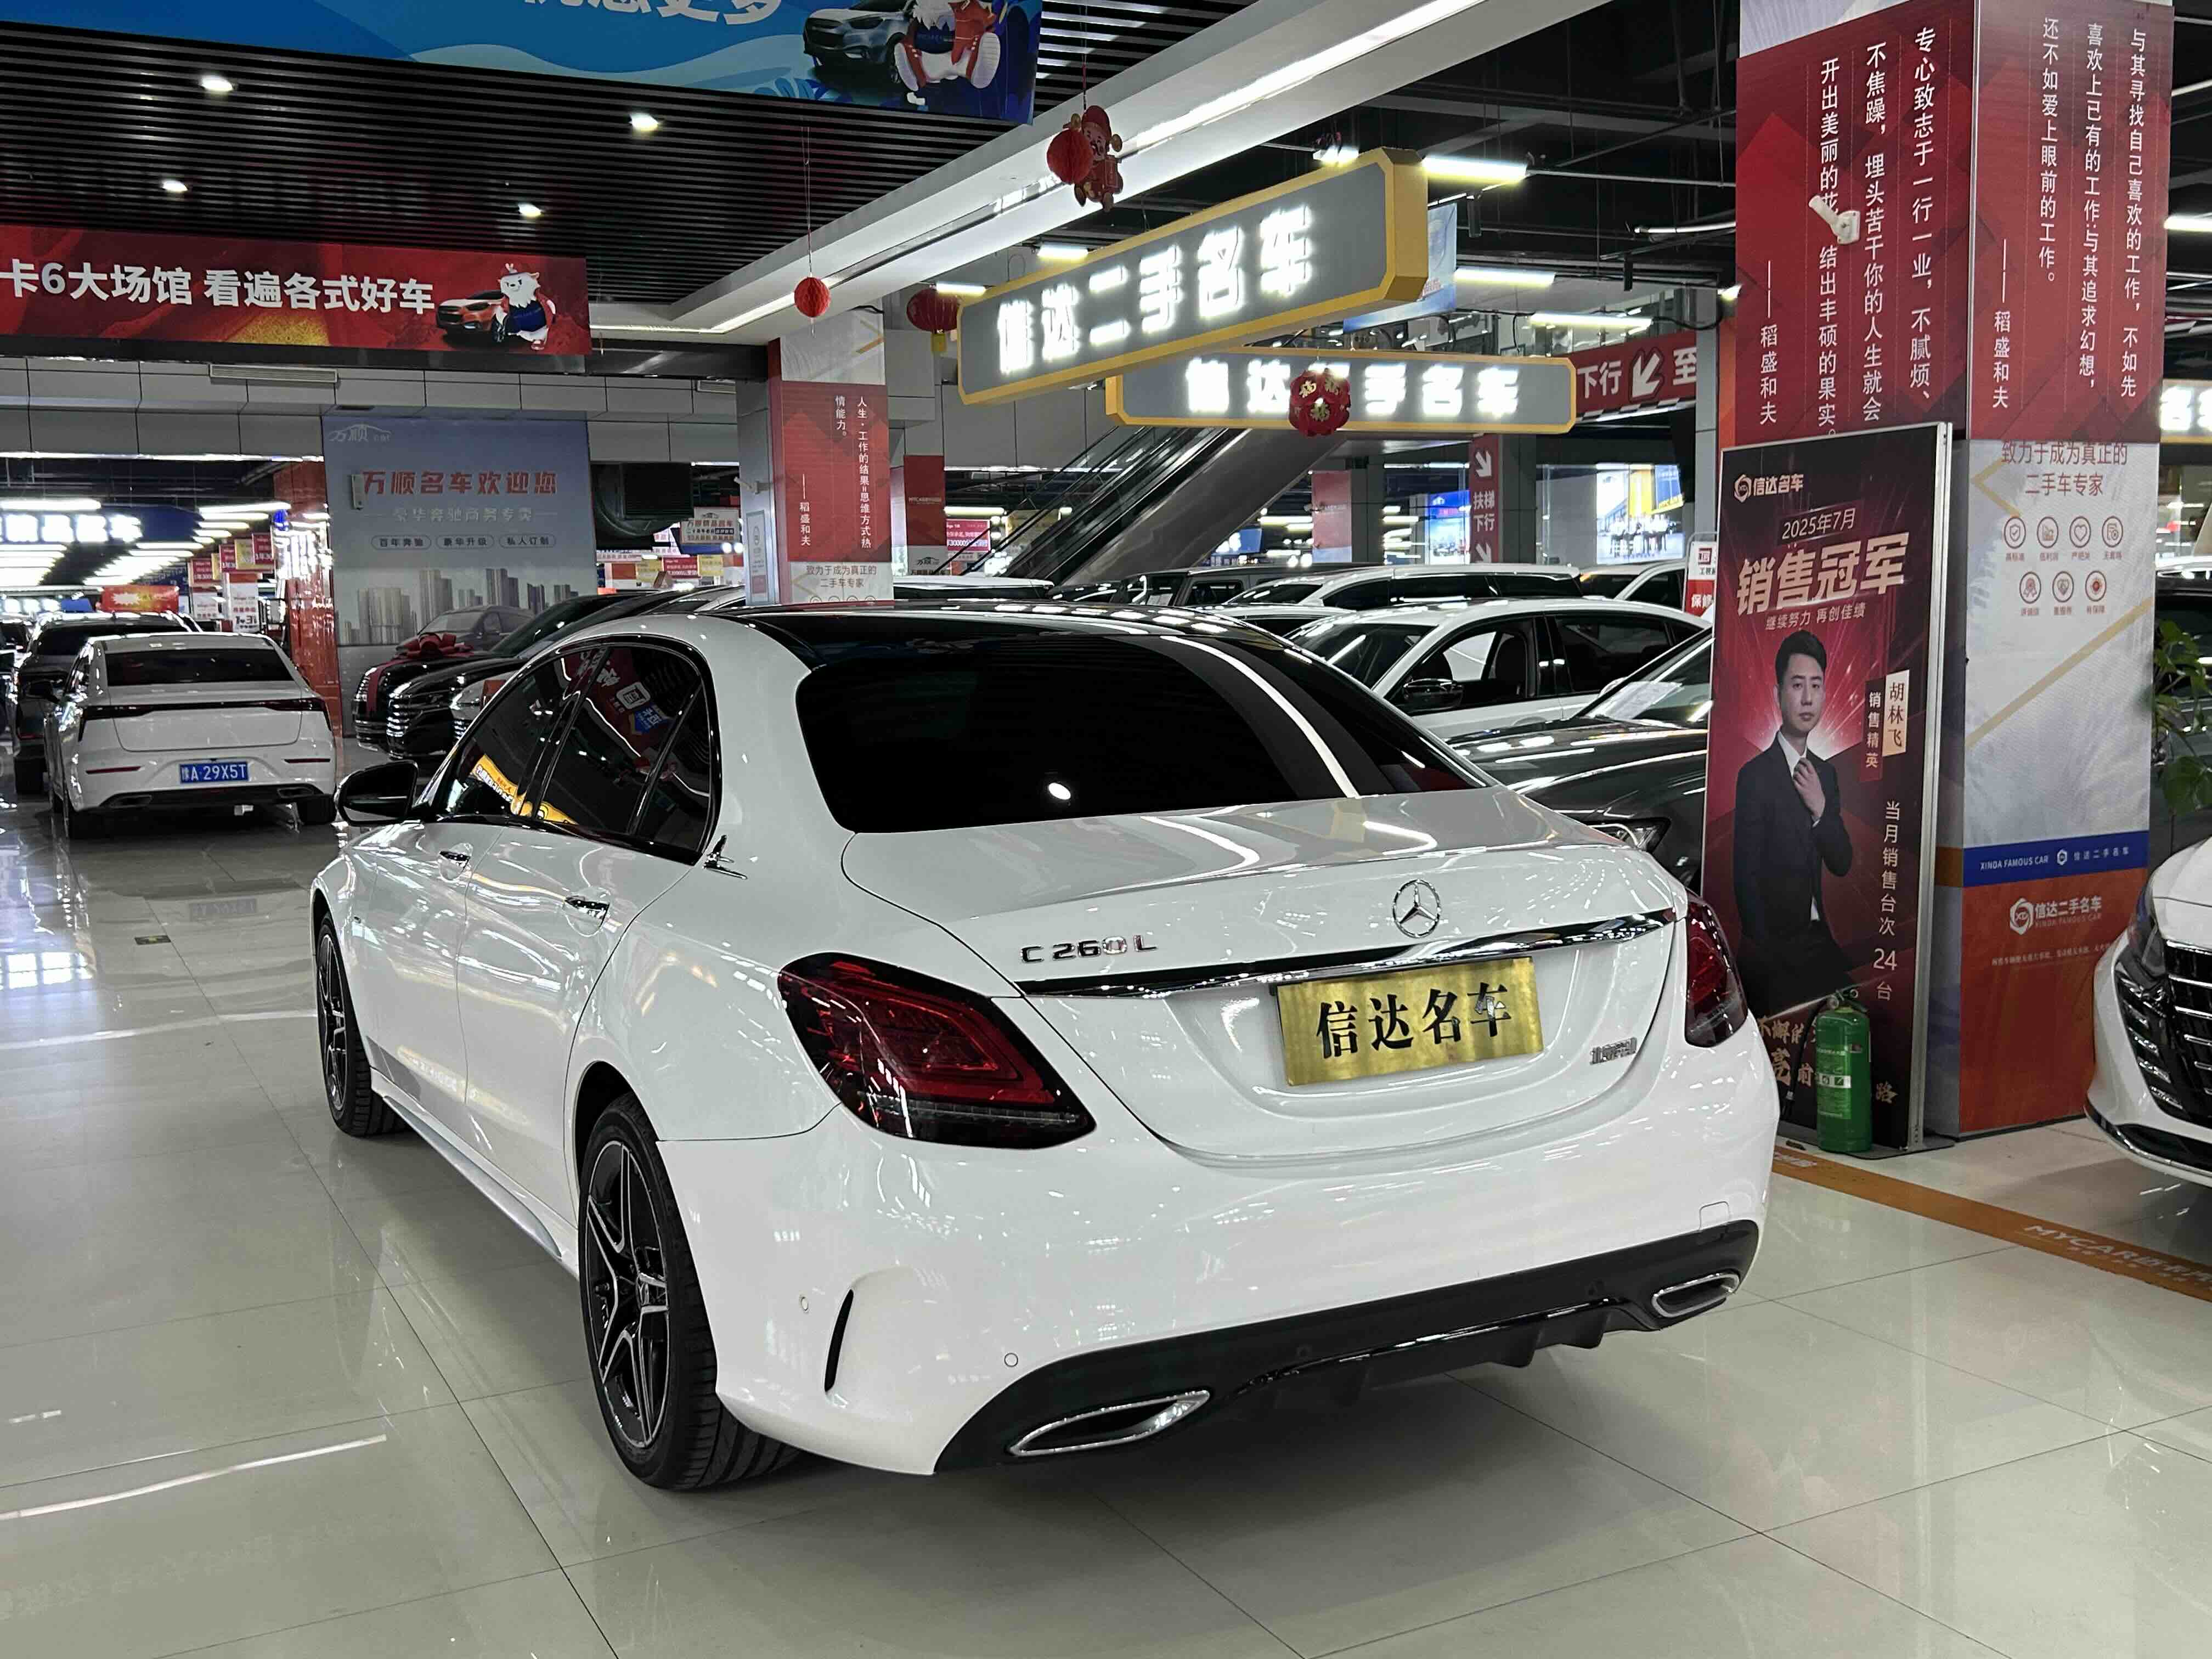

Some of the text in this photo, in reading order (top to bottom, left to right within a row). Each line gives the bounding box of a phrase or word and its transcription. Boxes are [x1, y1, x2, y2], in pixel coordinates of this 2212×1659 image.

[2039, 17, 2058, 281] 还不如爱上眼前的工作。
[0, 258, 435, 315] 卡6大场馆 看遍各式好车
[1578, 360, 1622, 398] 下行
[2001, 440, 2128, 466] 致力于成为真正的
[363, 470, 557, 494] 万顺名车欢迎您
[1753, 474, 1804, 496] 信达名车
[2025, 472, 2103, 496] 二手车专家
[1474, 491, 1495, 510] 扶梯
[1474, 514, 1495, 532] 下行
[1781, 508, 1856, 540] 2025年7月
[806, 566, 877, 575] 致力于成为真正的
[820, 578, 865, 588] 二手车专家
[1737, 532, 1909, 616] 销售冠军
[1765, 602, 1865, 630] 继续努力 再创佳绩
[1888, 682, 1905, 747] 胡林飞
[1866, 692, 1882, 768] 销售精英
[1980, 855, 2049, 871] XINDA FAMOUS CAR
[1874, 801, 1900, 1001] 当月销售台次 24 台
[2035, 895, 2102, 919] 信达二手名车
[1019, 934, 1157, 962] C 260 L
[1316, 982, 1511, 1059] 信达名车
